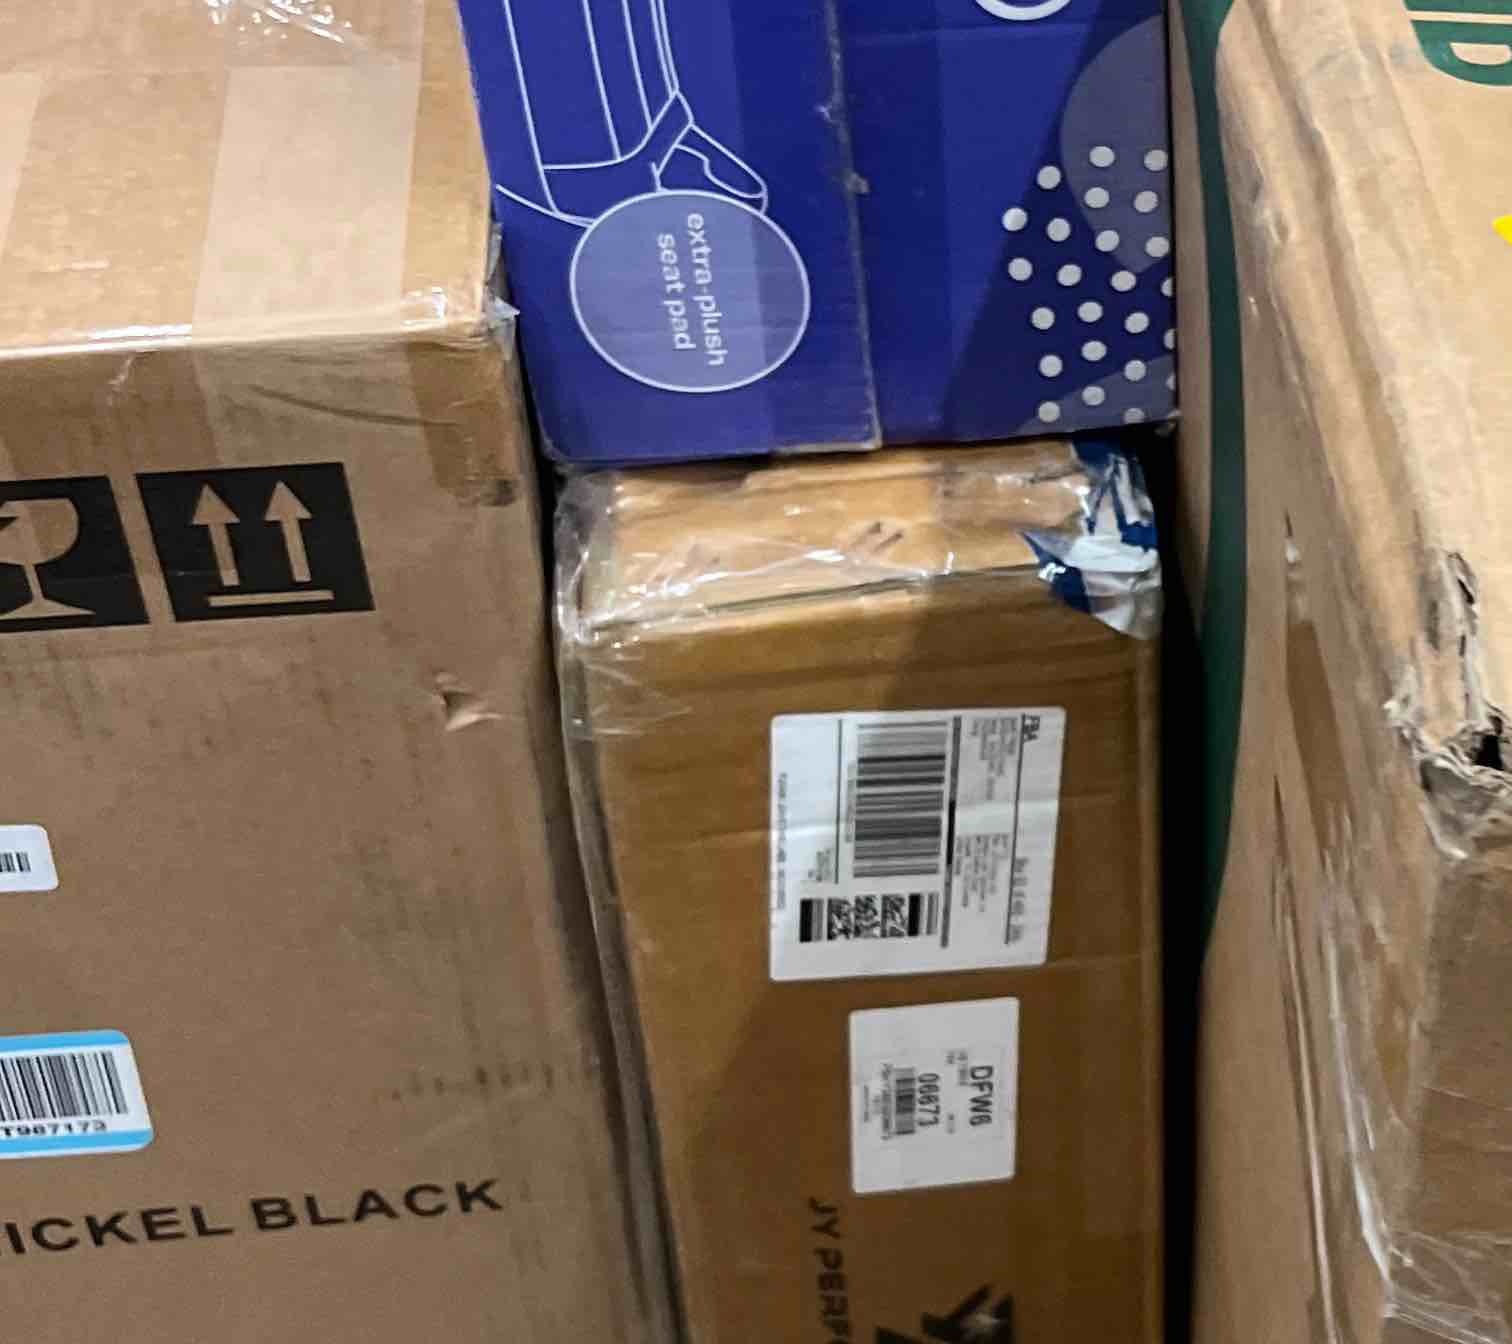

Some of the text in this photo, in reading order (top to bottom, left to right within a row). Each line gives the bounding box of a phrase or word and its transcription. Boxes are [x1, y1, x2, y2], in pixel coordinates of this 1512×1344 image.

[657, 233, 697, 350] seat pad
[687, 213, 728, 366] extra-plush
[0, 1178, 505, 1256] ICKEL BLACK
